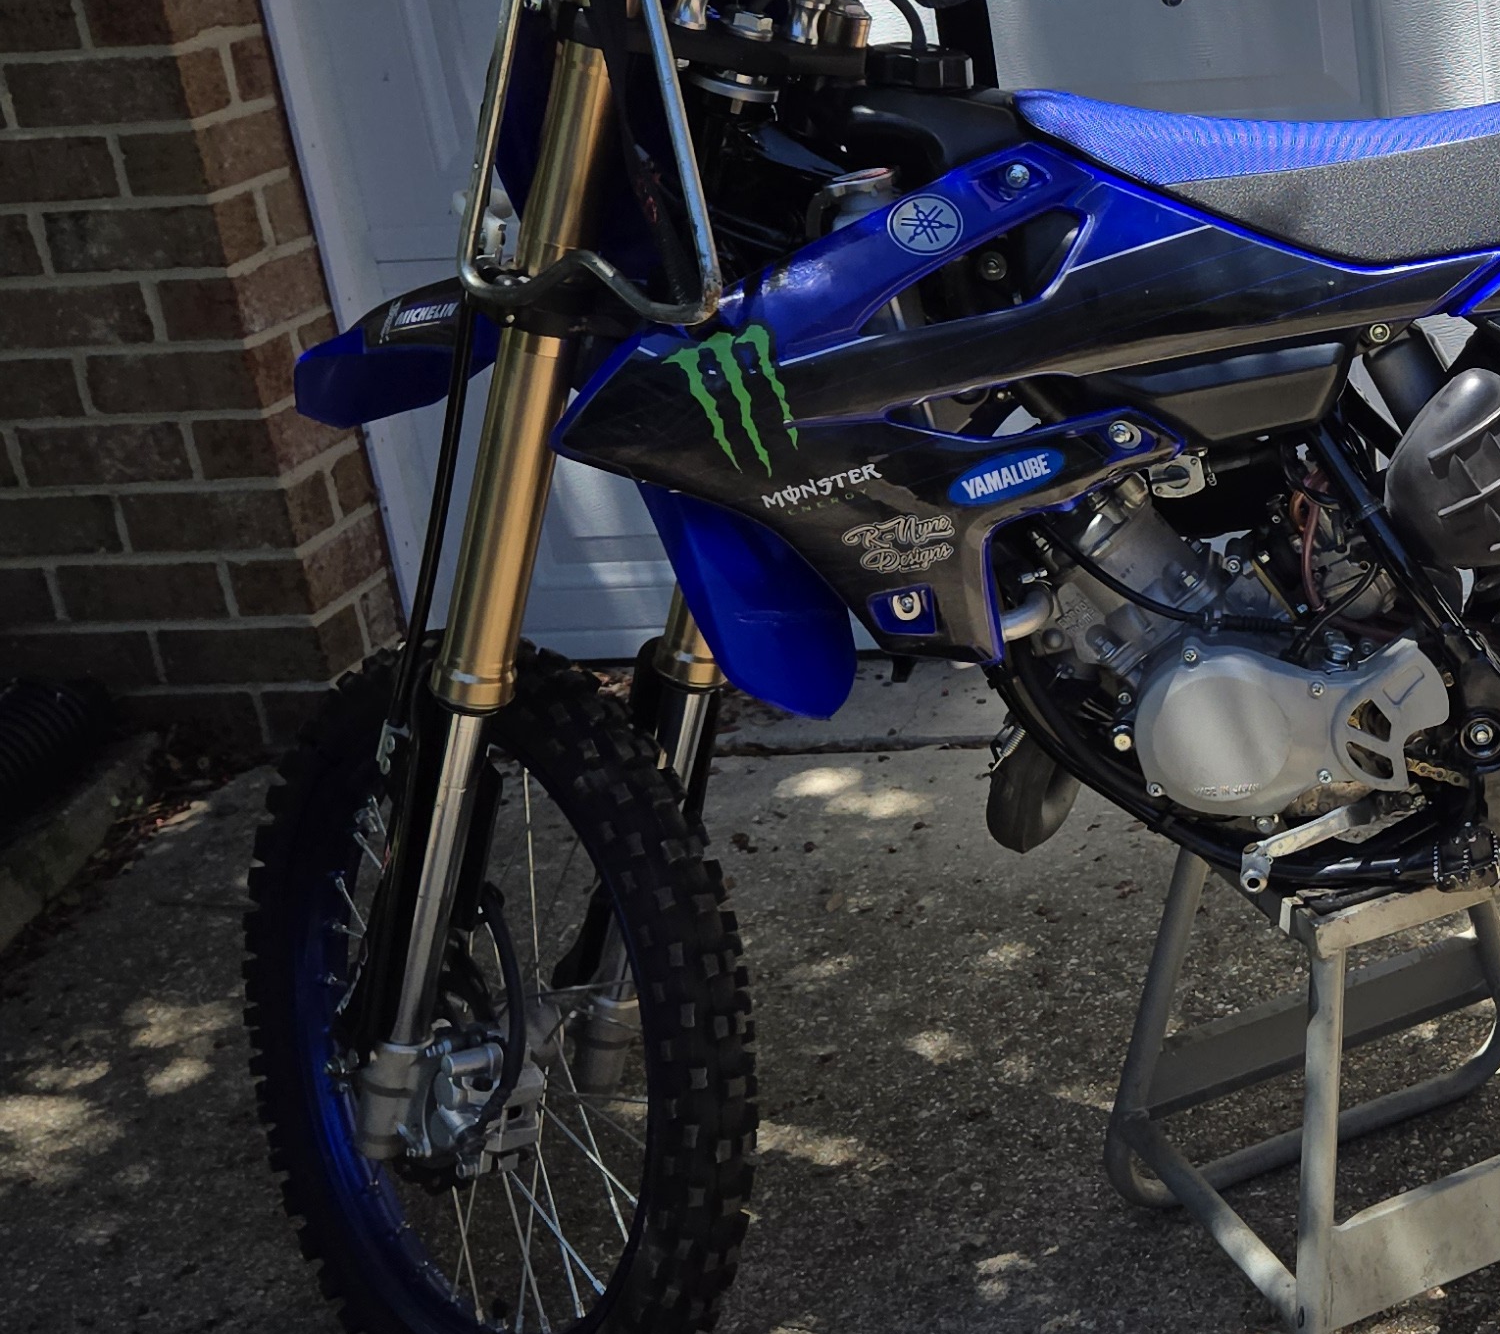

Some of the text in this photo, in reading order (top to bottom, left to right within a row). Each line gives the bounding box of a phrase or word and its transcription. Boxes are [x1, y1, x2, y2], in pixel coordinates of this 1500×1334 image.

[394, 301, 461, 327] MICHELIN
[761, 463, 883, 509] MONSTER
[961, 453, 1052, 500] YAMALUBE
[860, 542, 954, 573] Designs
